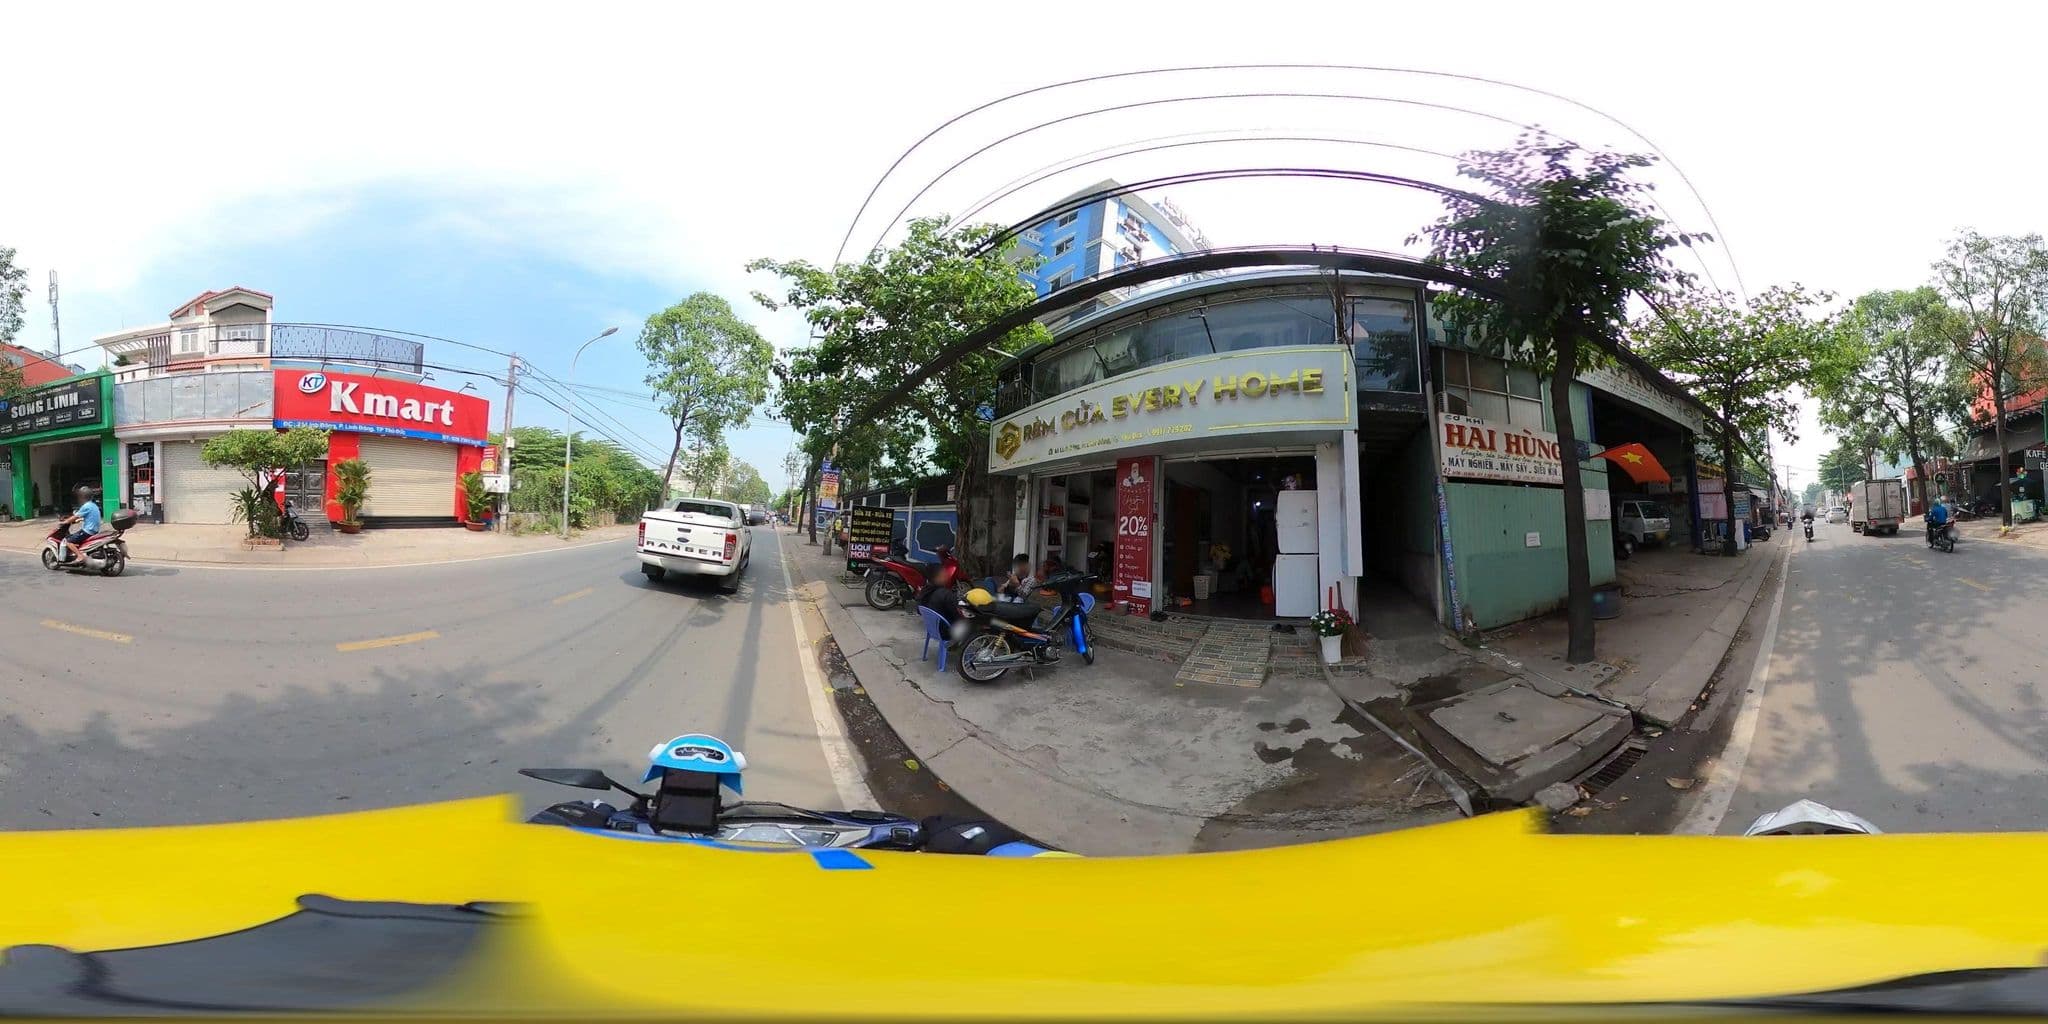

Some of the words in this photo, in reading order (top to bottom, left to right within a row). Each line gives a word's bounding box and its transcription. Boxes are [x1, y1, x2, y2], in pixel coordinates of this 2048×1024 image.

[11, 400, 44, 419] SONG
[46, 392, 79, 411] LINH
[329, 380, 454, 426] Kmart
[1061, 399, 1107, 431] CỬA
[1112, 376, 1205, 419] EVERY
[1213, 368, 1324, 401] HOME
[1444, 423, 1497, 452] HAI
[1448, 455, 1465, 468] MÁY
[2026, 449, 2048, 458] KAFE
[1119, 516, 1147, 535] 20%
[646, 540, 722, 557] RANGER
